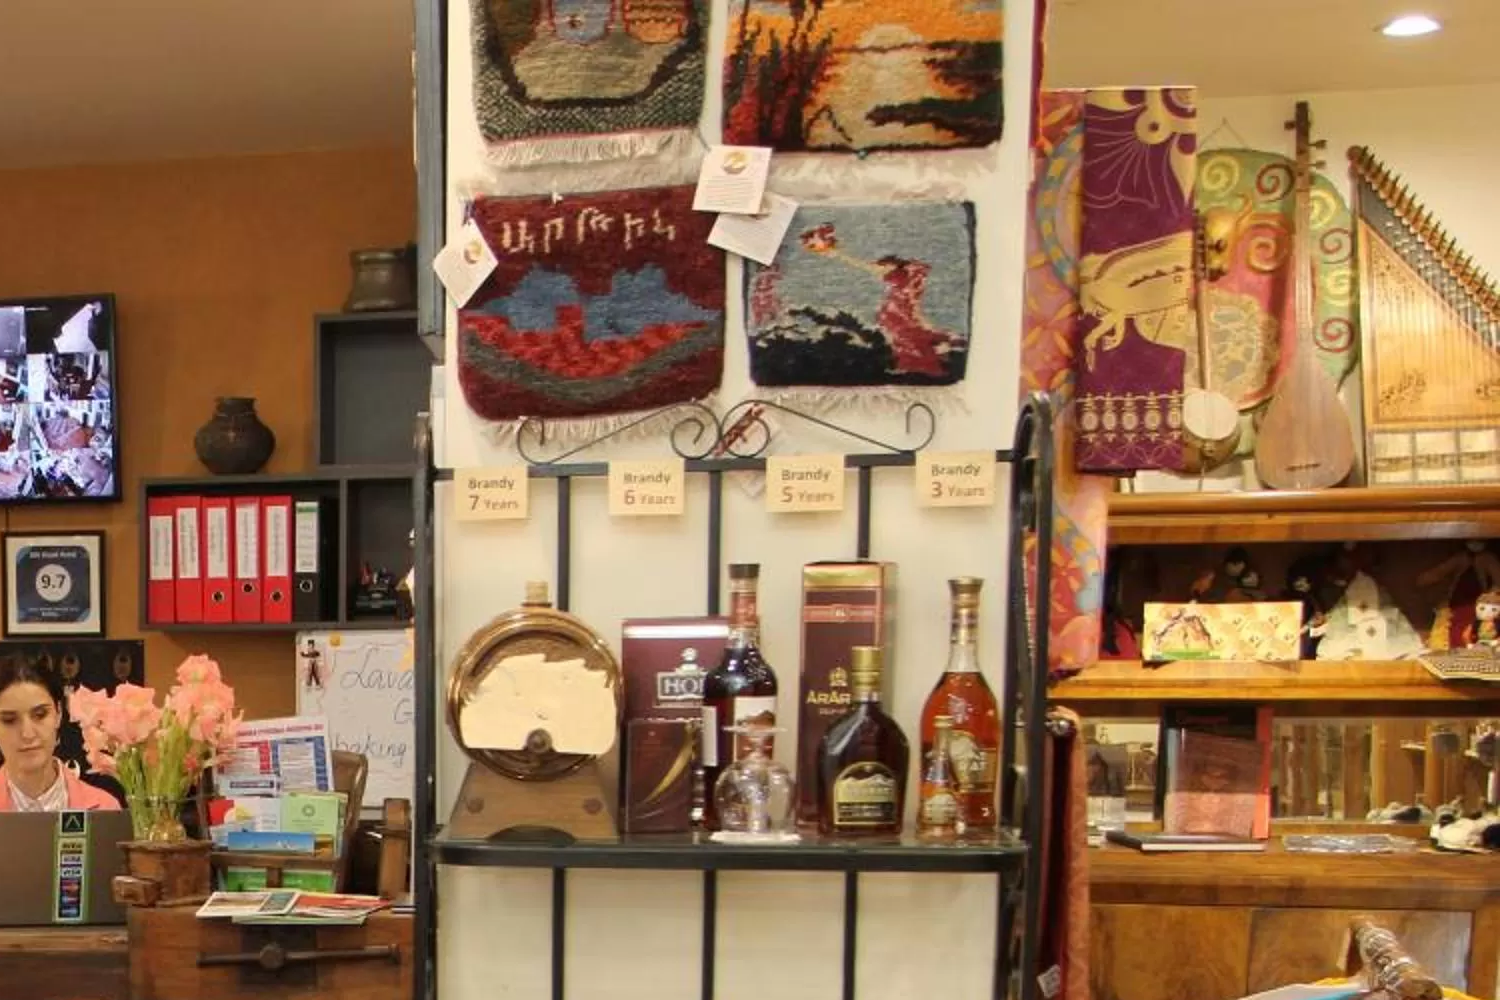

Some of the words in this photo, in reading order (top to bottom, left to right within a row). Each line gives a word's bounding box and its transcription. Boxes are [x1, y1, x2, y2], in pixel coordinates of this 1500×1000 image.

[623, 471, 672, 485] Brandy
[781, 468, 832, 482] Brandy
[931, 463, 982, 477] Brandy
[467, 476, 516, 491] Brandy
[931, 482, 943, 498] 3
[948, 485, 985, 497] Years
[468, 495, 480, 511] 7
[484, 498, 519, 510] Years
[624, 489, 635, 506] 6
[640, 493, 676, 505] Years
[782, 487, 794, 503] 5
[798, 490, 835, 502] Years
[41, 573, 66, 589] 9.7
[339, 646, 413, 691] Lava
[805, 689, 852, 705] ARAR
